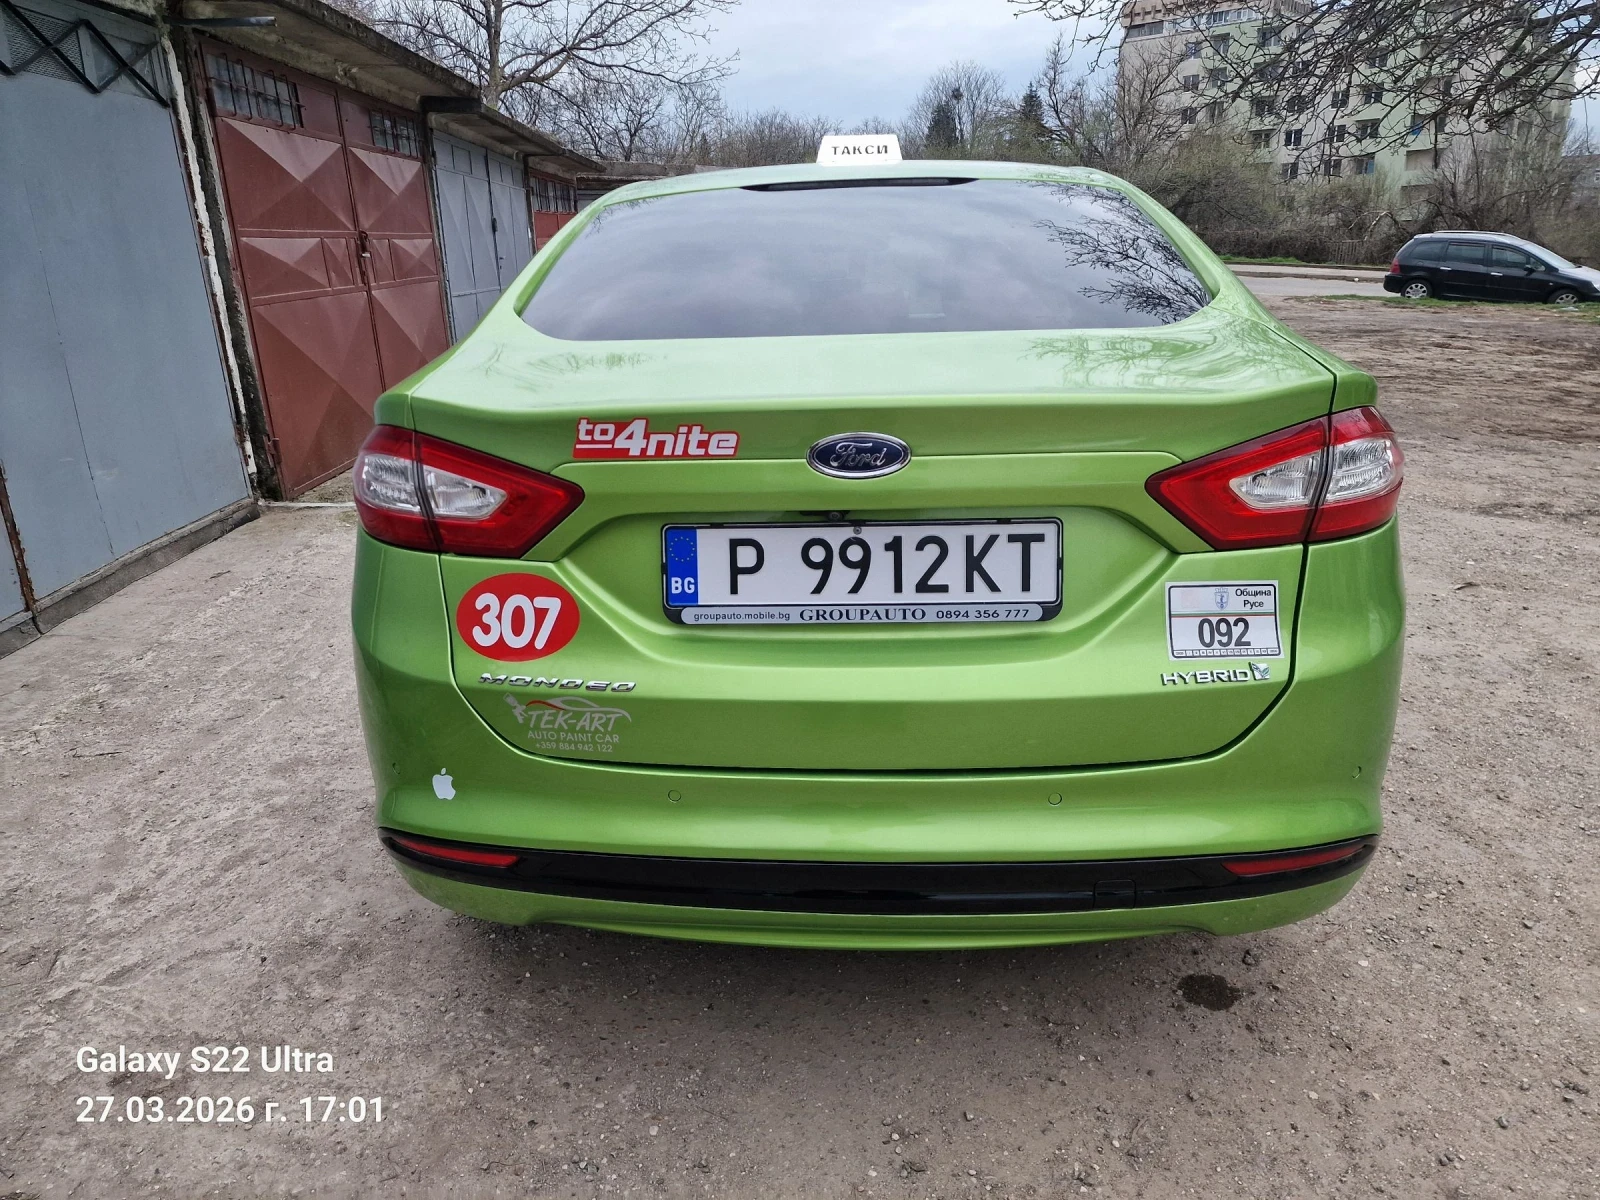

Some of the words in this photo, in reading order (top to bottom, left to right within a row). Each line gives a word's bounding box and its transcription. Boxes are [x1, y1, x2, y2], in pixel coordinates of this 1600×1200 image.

[831, 145, 888, 155] ТАКСИ
[829, 442, 887, 467] Ford
[728, 538, 765, 595] P
[671, 576, 695, 594] BG
[1235, 588, 1272, 598] Община
[1243, 600, 1265, 610] Русе
[472, 592, 562, 650] 307
[693, 611, 791, 622] groupauto.mobile.bg
[799, 608, 927, 622] GROUPAUTO
[936, 609, 970, 620] 0894
[974, 609, 1000, 619] 356
[1005, 609, 1030, 618] 777
[1197, 617, 1252, 648] 092
[478, 672, 637, 693] MONDEO
[1160, 669, 1251, 686] HYBRID
[527, 709, 623, 732] TEK-ART
[527, 730, 558, 740] AUTO
[560, 732, 593, 742] PAINT
[595, 733, 620, 743] CAR
[535, 741, 557, 750] +359
[559, 742, 576, 751] 884
[577, 743, 594, 752] 942
[597, 744, 613, 753] 122
